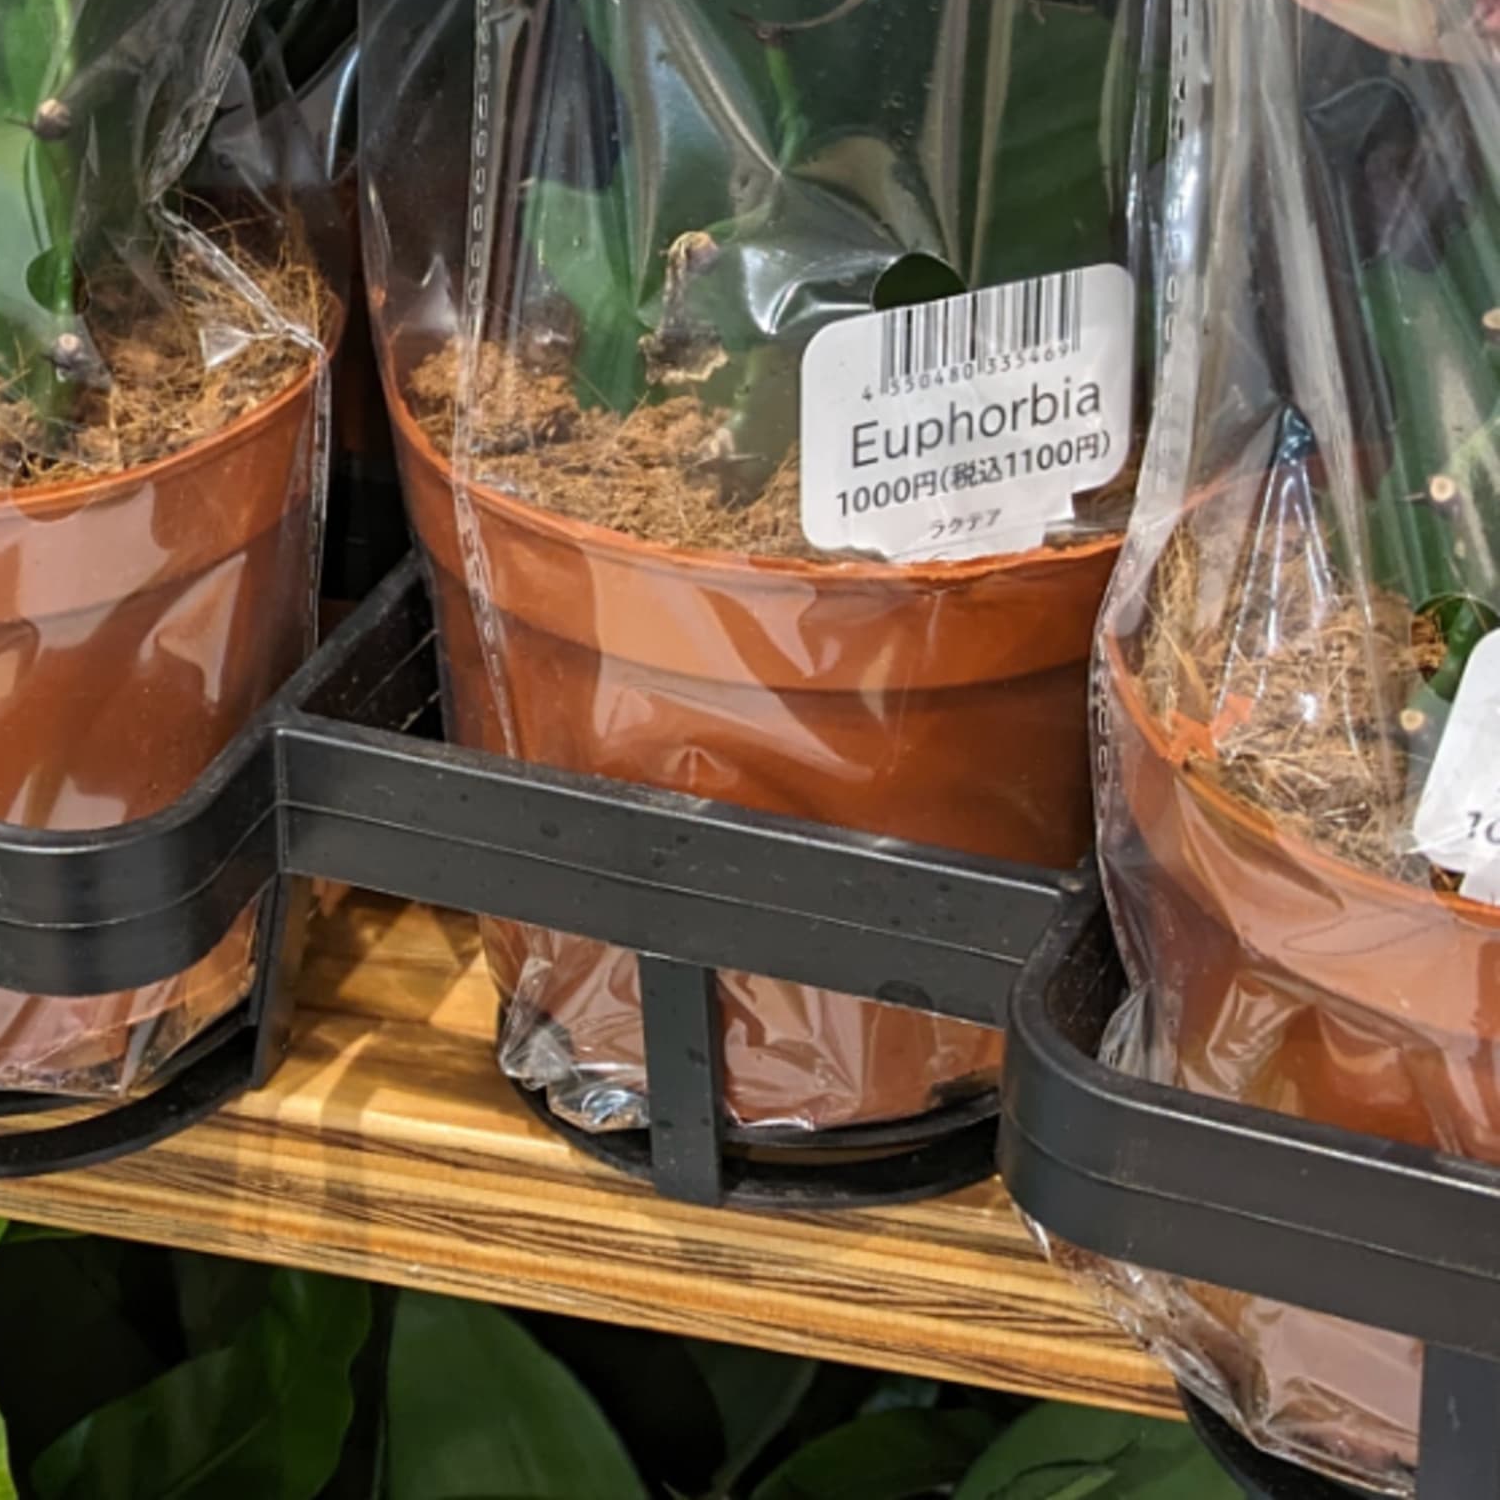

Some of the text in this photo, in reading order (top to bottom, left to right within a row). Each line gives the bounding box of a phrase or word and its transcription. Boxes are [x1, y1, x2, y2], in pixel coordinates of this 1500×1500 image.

[851, 376, 1101, 469] Euphorbia
[836, 429, 1111, 518] 1000円(税込1100円)
